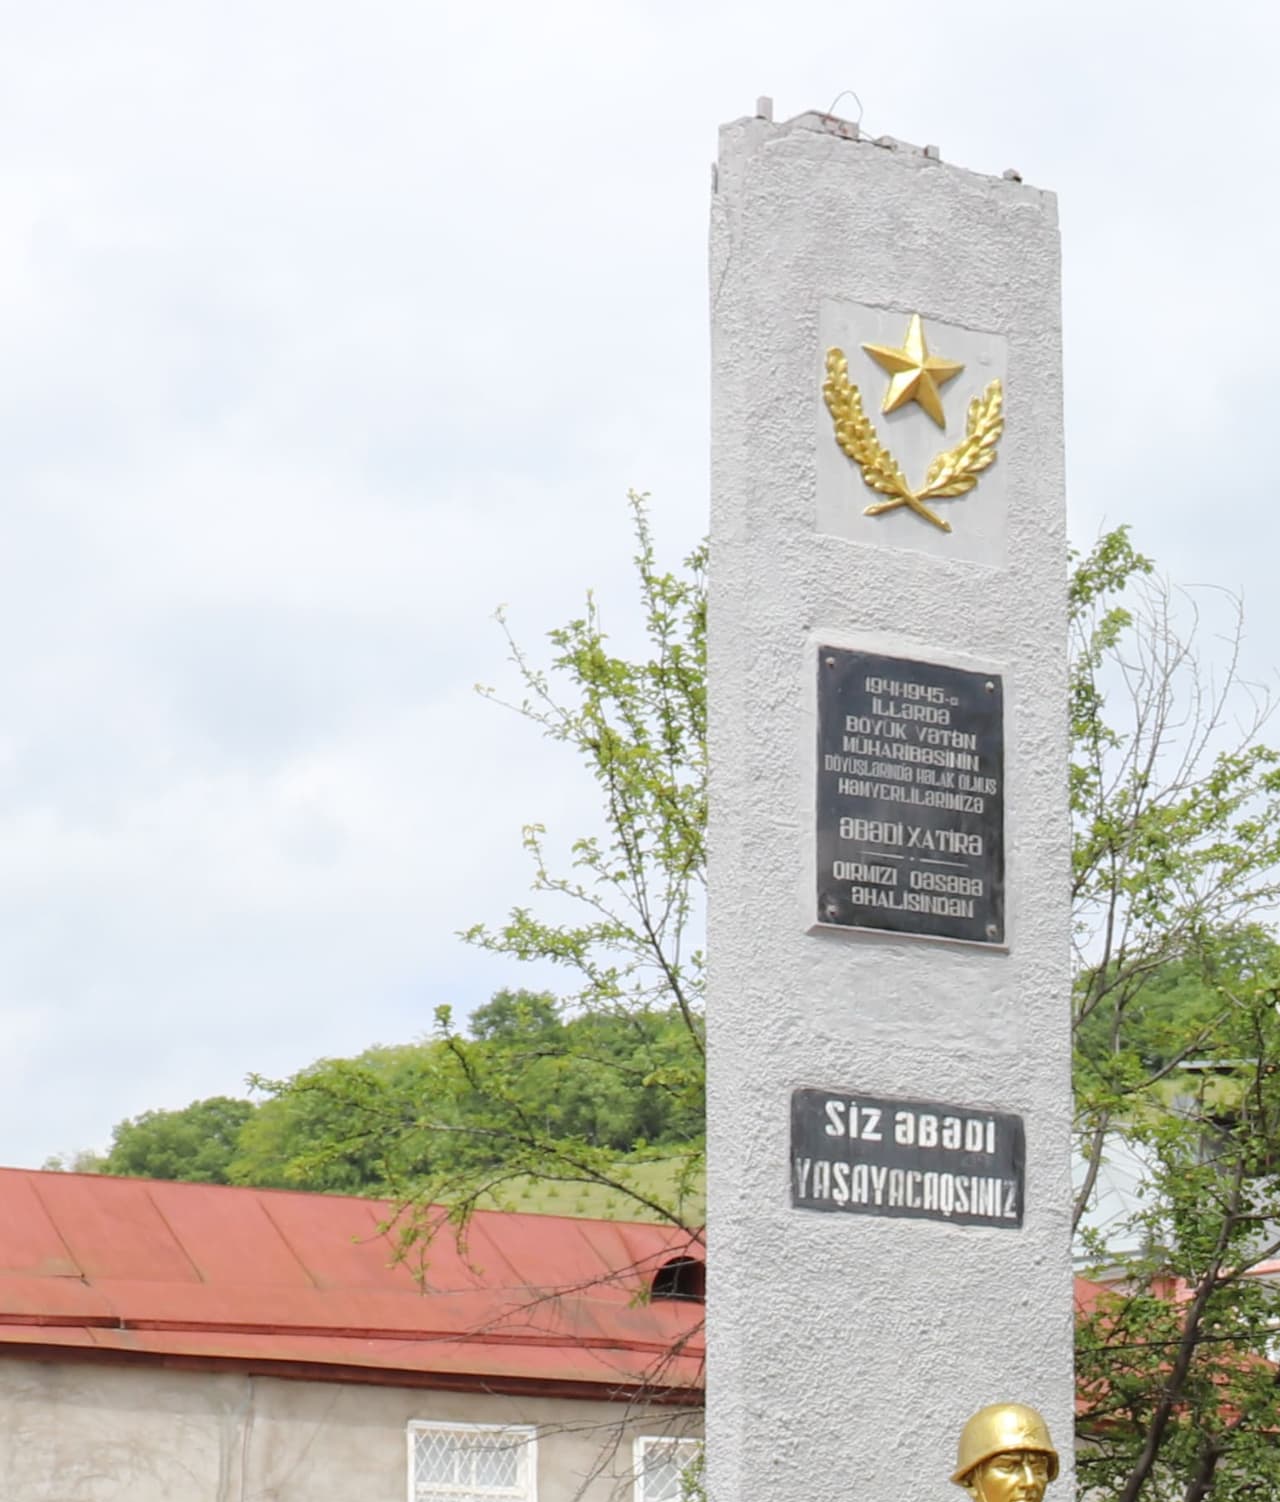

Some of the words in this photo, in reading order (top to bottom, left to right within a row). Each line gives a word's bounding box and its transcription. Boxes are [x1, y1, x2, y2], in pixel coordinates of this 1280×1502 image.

[915, 725, 977, 750] VƏTƏN
[839, 816, 903, 846] ƏBƏDİ
[907, 825, 984, 856] XATİRƏ
[832, 860, 898, 886] QIRMIZI
[909, 870, 984, 897] QƏSƏBƏ
[851, 886, 975, 918] ƏHALİSİNDƏN
[825, 1100, 883, 1141] SİZ
[894, 1110, 996, 1154] ƏBƏDİ
[796, 1157, 1018, 1218] YAŞAYACAQSINIZ
